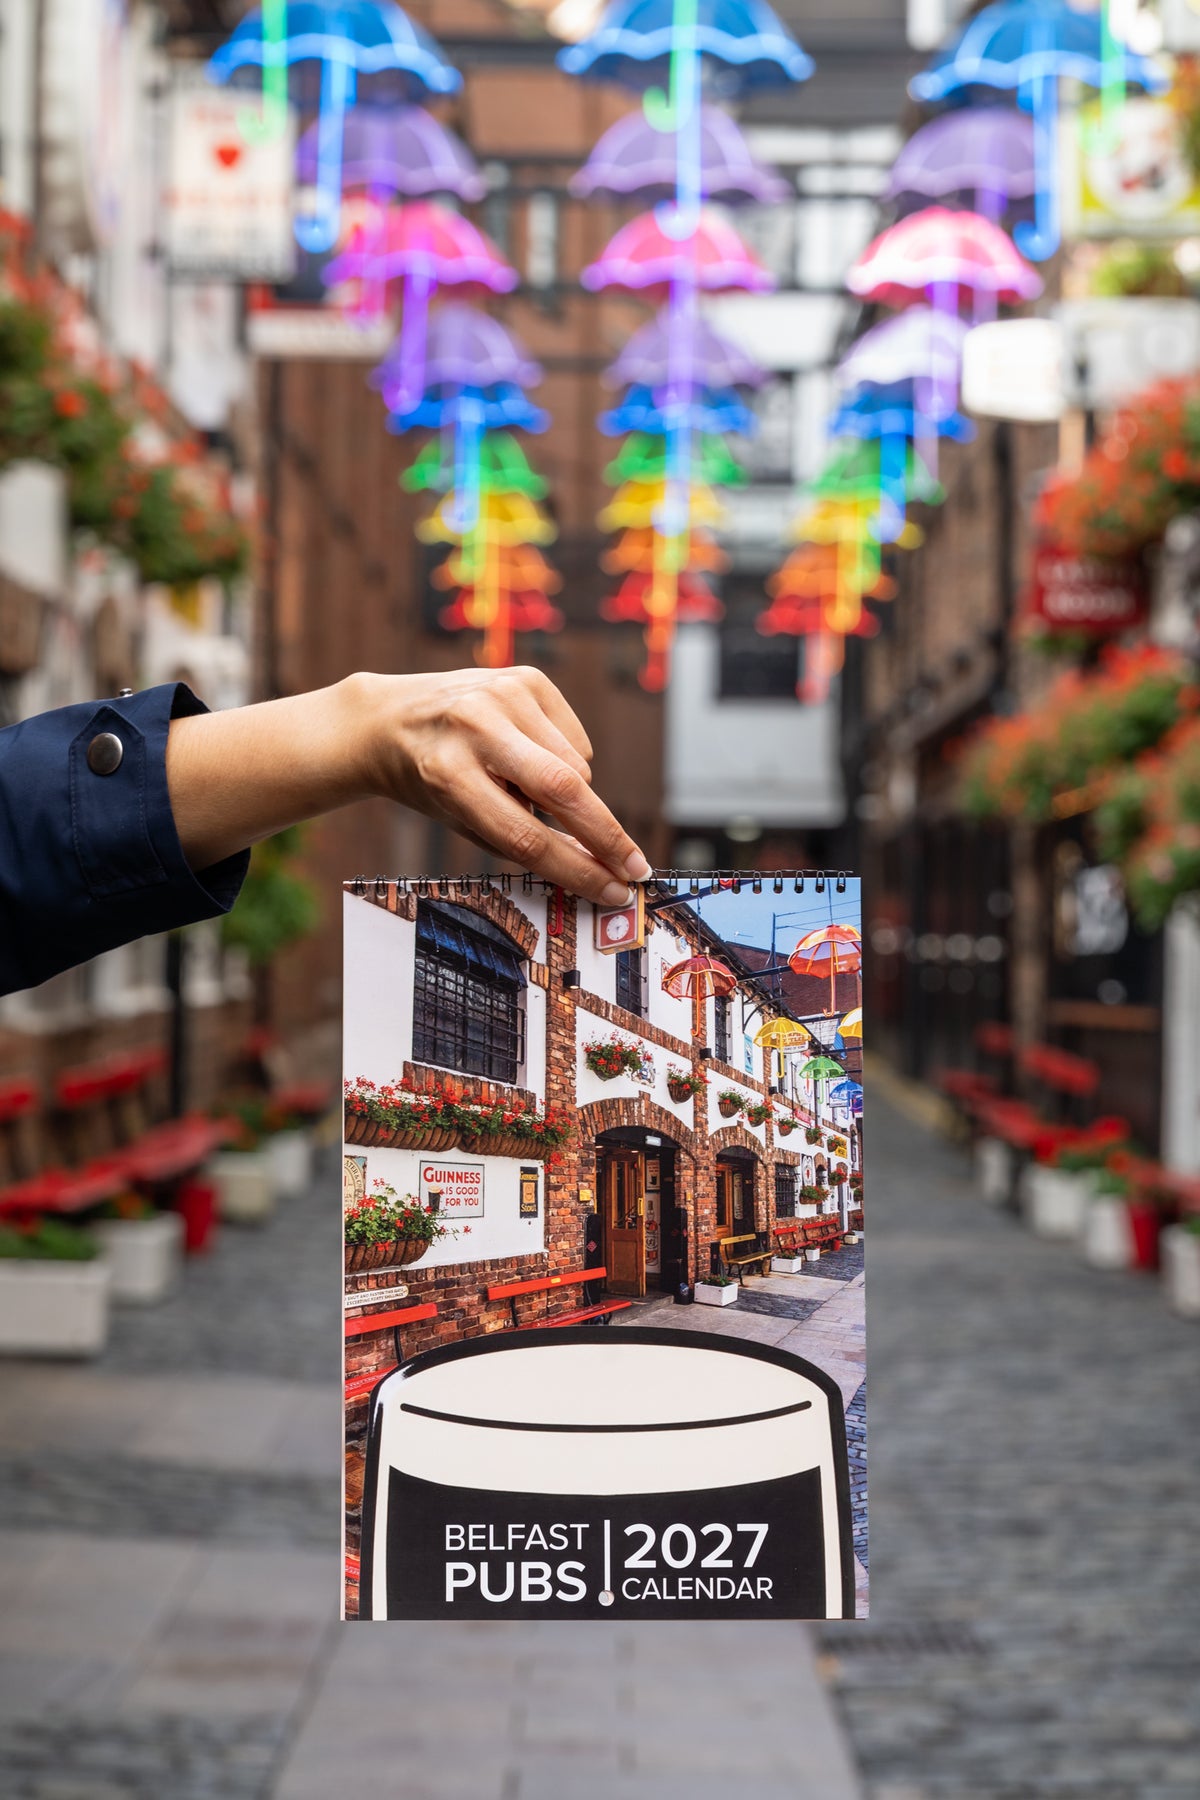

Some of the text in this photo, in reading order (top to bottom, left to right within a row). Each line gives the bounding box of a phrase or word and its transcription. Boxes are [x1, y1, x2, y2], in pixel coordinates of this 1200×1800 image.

[423, 1166, 481, 1184] GUINNESS
[445, 1186, 479, 1195] IS GOOD
[445, 1197, 479, 1206] FOR YOU
[445, 1523, 590, 1551] BELFAST
[623, 1523, 769, 1569] 2027
[445, 1560, 587, 1603] PUBS
[621, 1577, 773, 1600] CALENDAR
